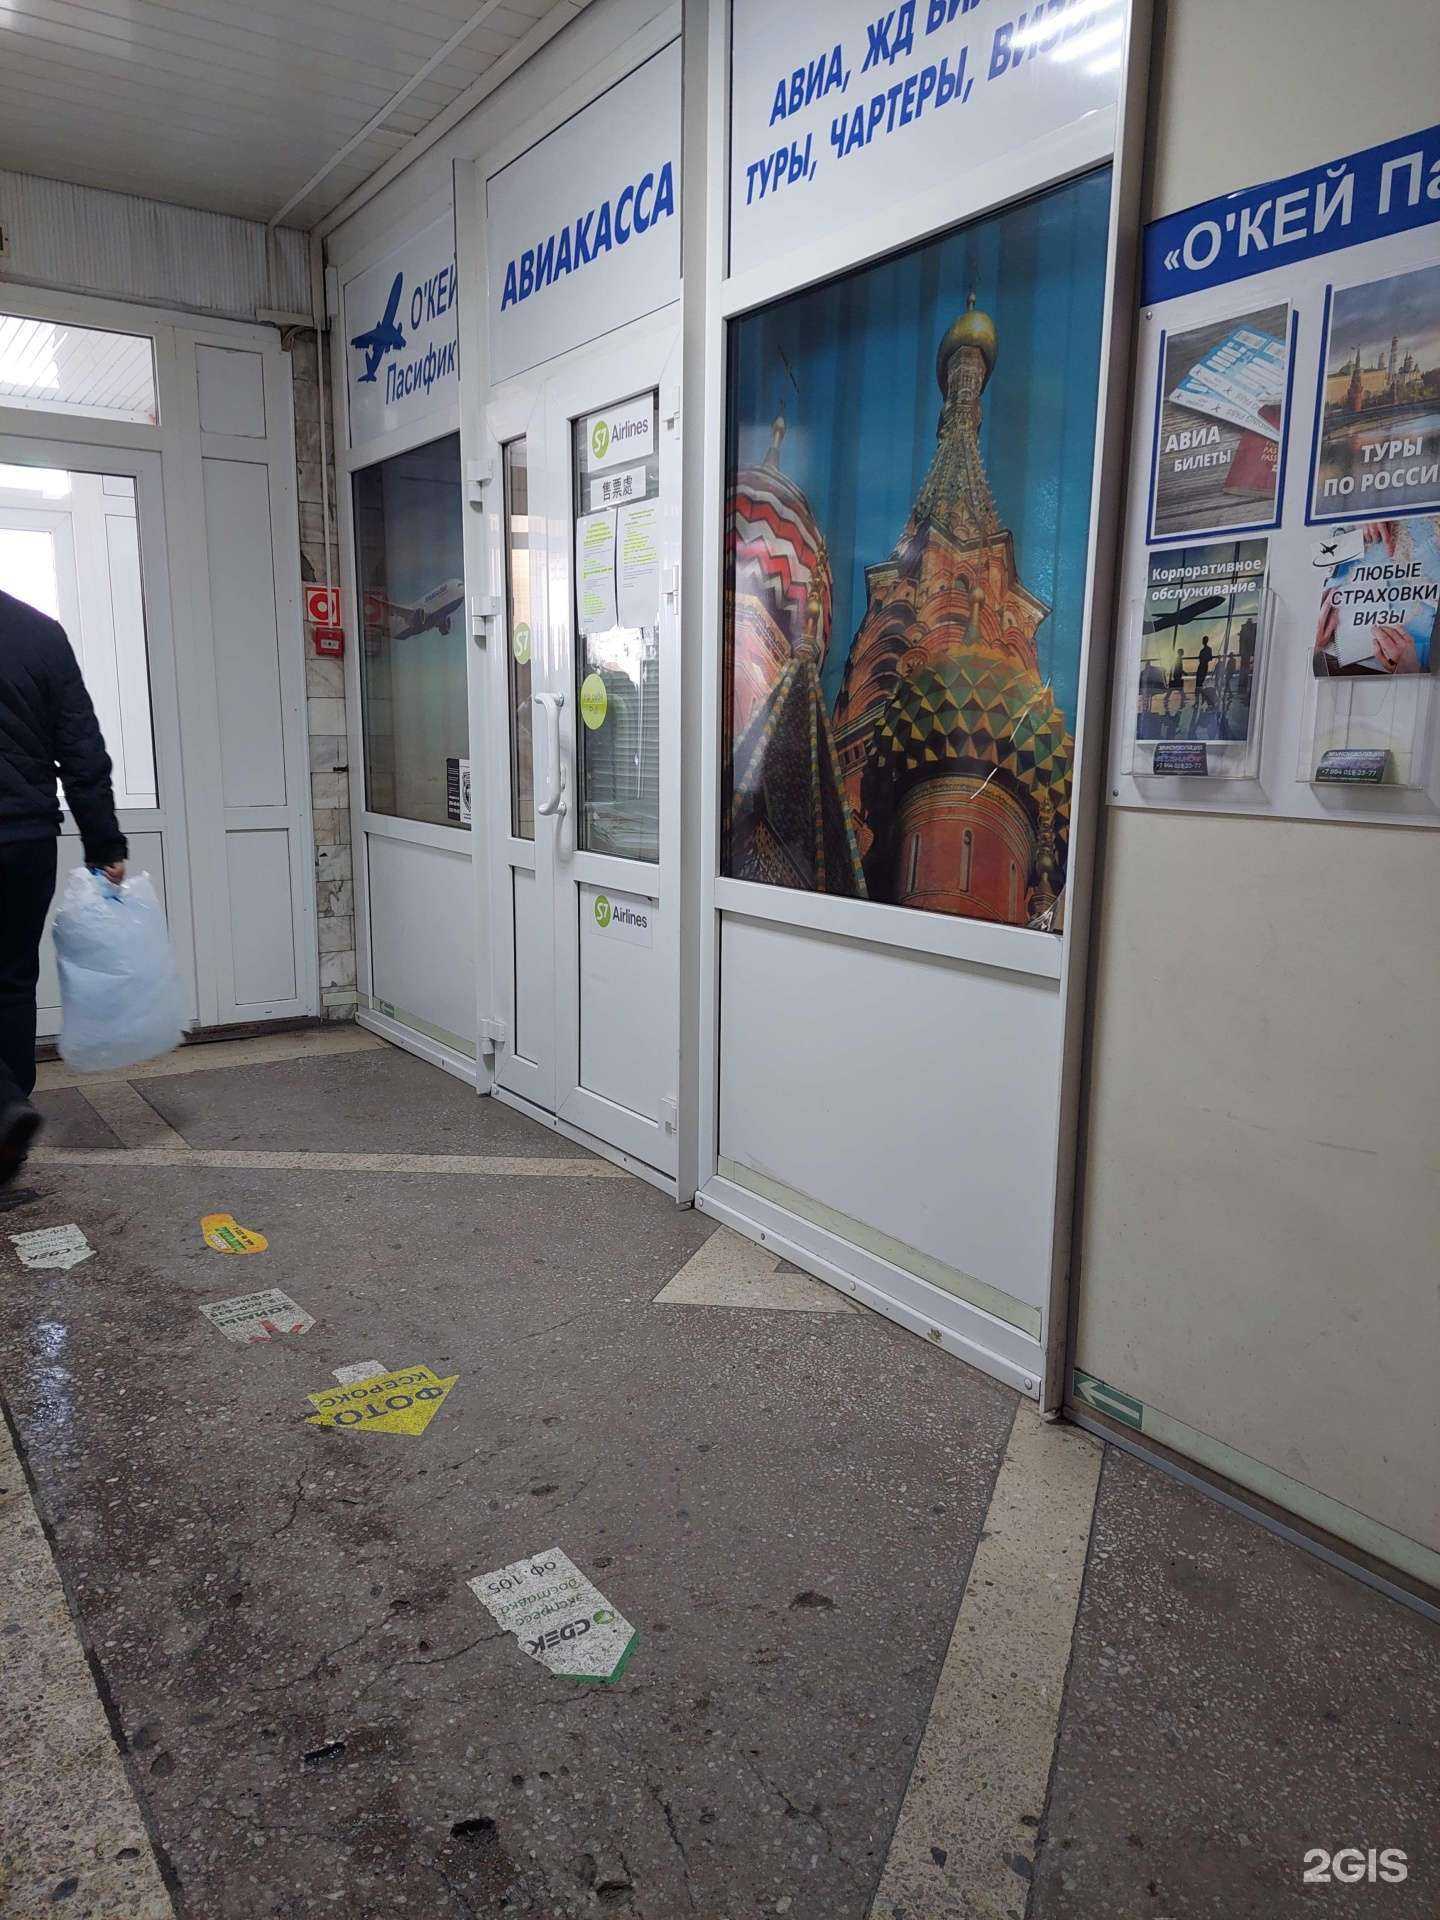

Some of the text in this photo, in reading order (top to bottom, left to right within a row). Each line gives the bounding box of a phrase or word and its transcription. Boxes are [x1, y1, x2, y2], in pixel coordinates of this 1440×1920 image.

[769, 44, 851, 127] АВИА,
[861, 0, 916, 74] ЖД
[746, 133, 817, 205] ТУРЫ,
[831, 46, 974, 159] ЧАРТЕРЫ,
[1163, 163, 1356, 272] «О'КЕЙ
[500, 161, 674, 313] АВИАКАССА
[386, 339, 457, 406] Пасифик
[611, 418, 649, 443] Airlines
[1165, 425, 1222, 453] АВИА
[1174, 450, 1232, 473] БИЛЕТЫ
[1361, 436, 1424, 463] ТУРЫ
[1323, 463, 1440, 497] ПО РОССИ
[1152, 557, 1262, 583] Корпоративное
[1353, 562, 1422, 583] ЛЮБЫЕ
[1152, 580, 1257, 601] обслуживание
[1331, 584, 1439, 606] СТРАХОВКИ
[1353, 609, 1406, 627] ВИЗЫ
[613, 906, 648, 929] Airlines
[320, 1372, 429, 1408] КСЕРОКС
[333, 1387, 444, 1426] ФОТО
[488, 1574, 524, 1595] 105
[500, 1577, 582, 1616] доставка
[515, 1594, 585, 1627] экспресс
[526, 1618, 591, 1655] CDEK
